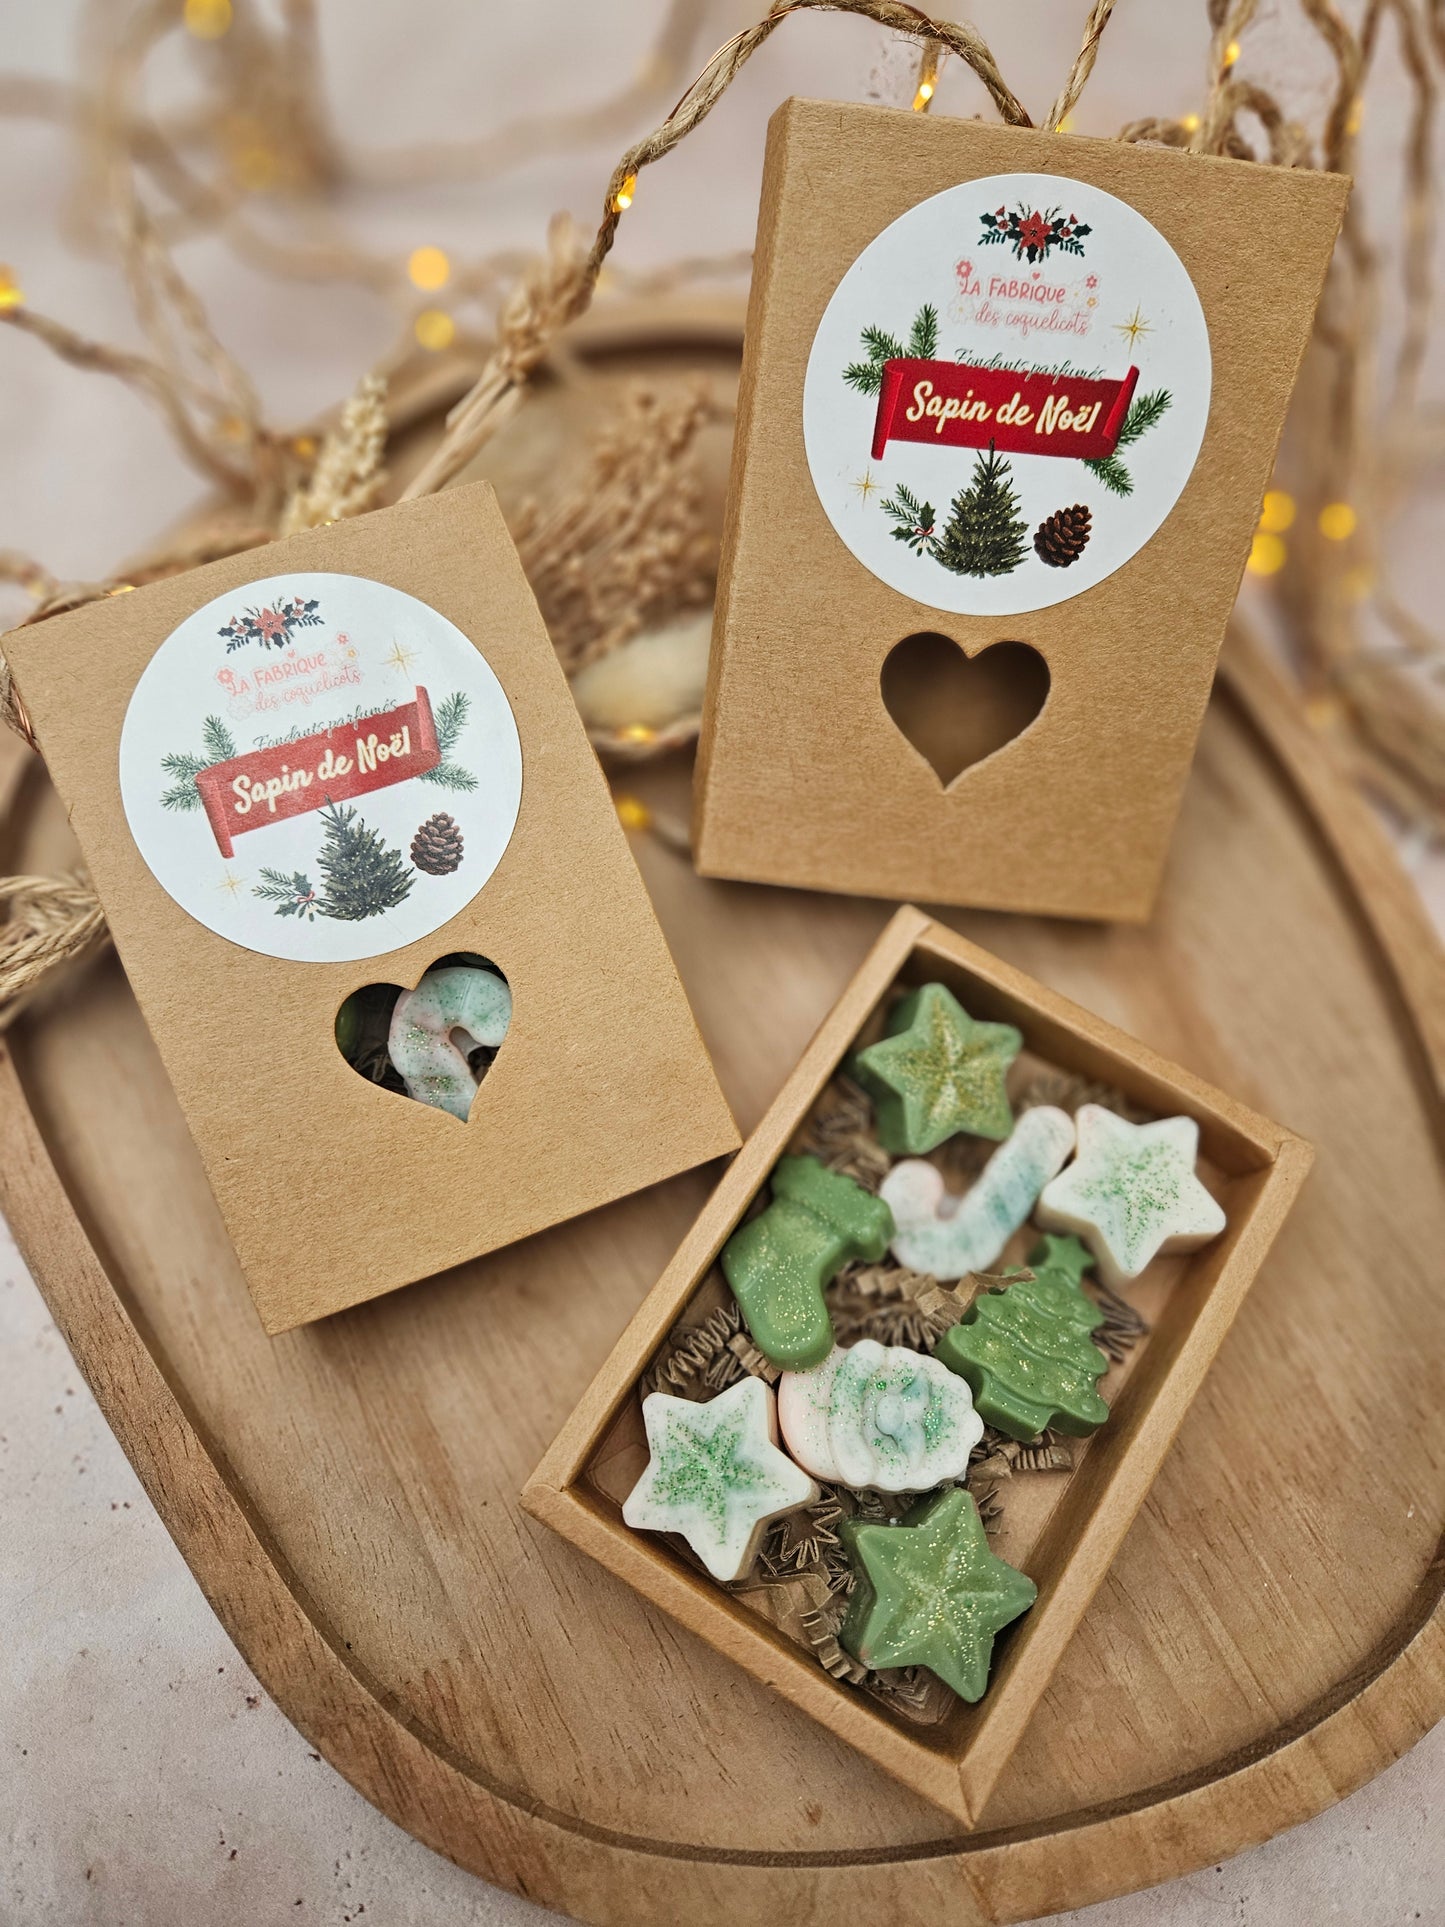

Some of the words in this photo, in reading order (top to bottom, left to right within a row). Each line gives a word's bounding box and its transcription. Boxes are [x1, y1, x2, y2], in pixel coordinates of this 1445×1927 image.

[988, 278, 1066, 303] FABRIQUE
[975, 301, 998, 327] des
[1006, 309, 1088, 336] coquelicots
[906, 381, 992, 434] Sapin
[996, 392, 1034, 426] de
[1035, 395, 1102, 435] Noël
[254, 653, 326, 688] FABRIQUE
[256, 691, 278, 711] des
[284, 665, 361, 705] coquelicots
[232, 765, 314, 814] Sapin
[318, 749, 353, 781] de
[356, 726, 411, 774] Noël
